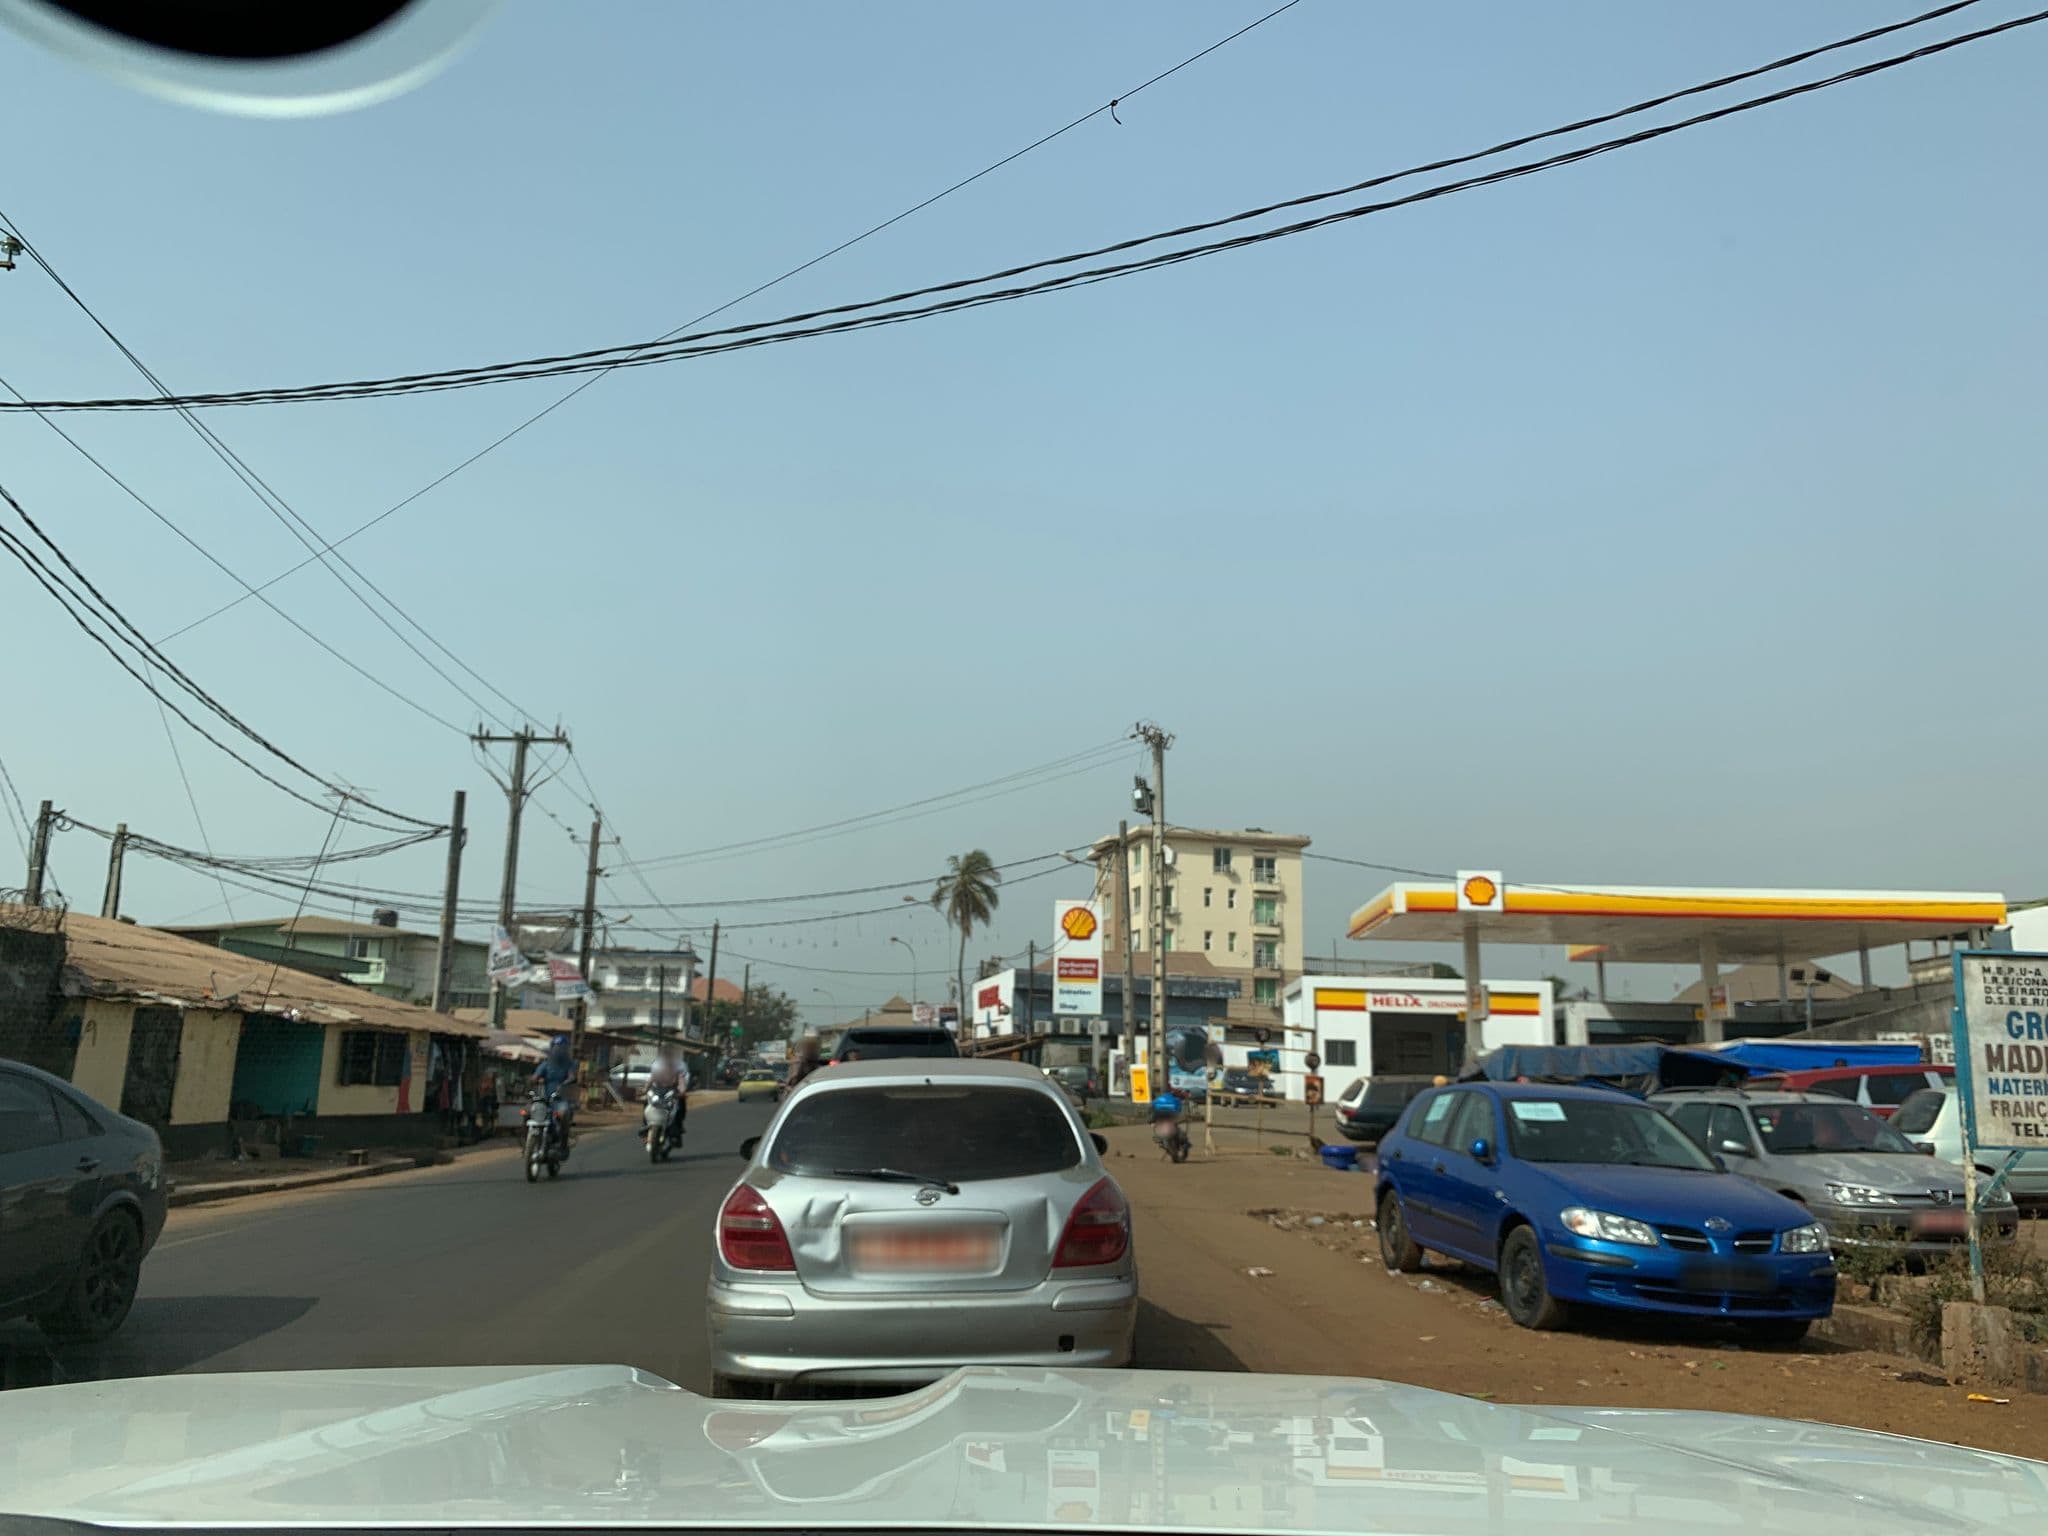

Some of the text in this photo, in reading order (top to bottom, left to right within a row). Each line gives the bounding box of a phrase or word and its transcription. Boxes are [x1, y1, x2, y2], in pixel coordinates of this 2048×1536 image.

[1372, 993, 1423, 1008] HELIX
[2006, 1010, 2048, 1040] GR
[1984, 1043, 2048, 1074] MAD
